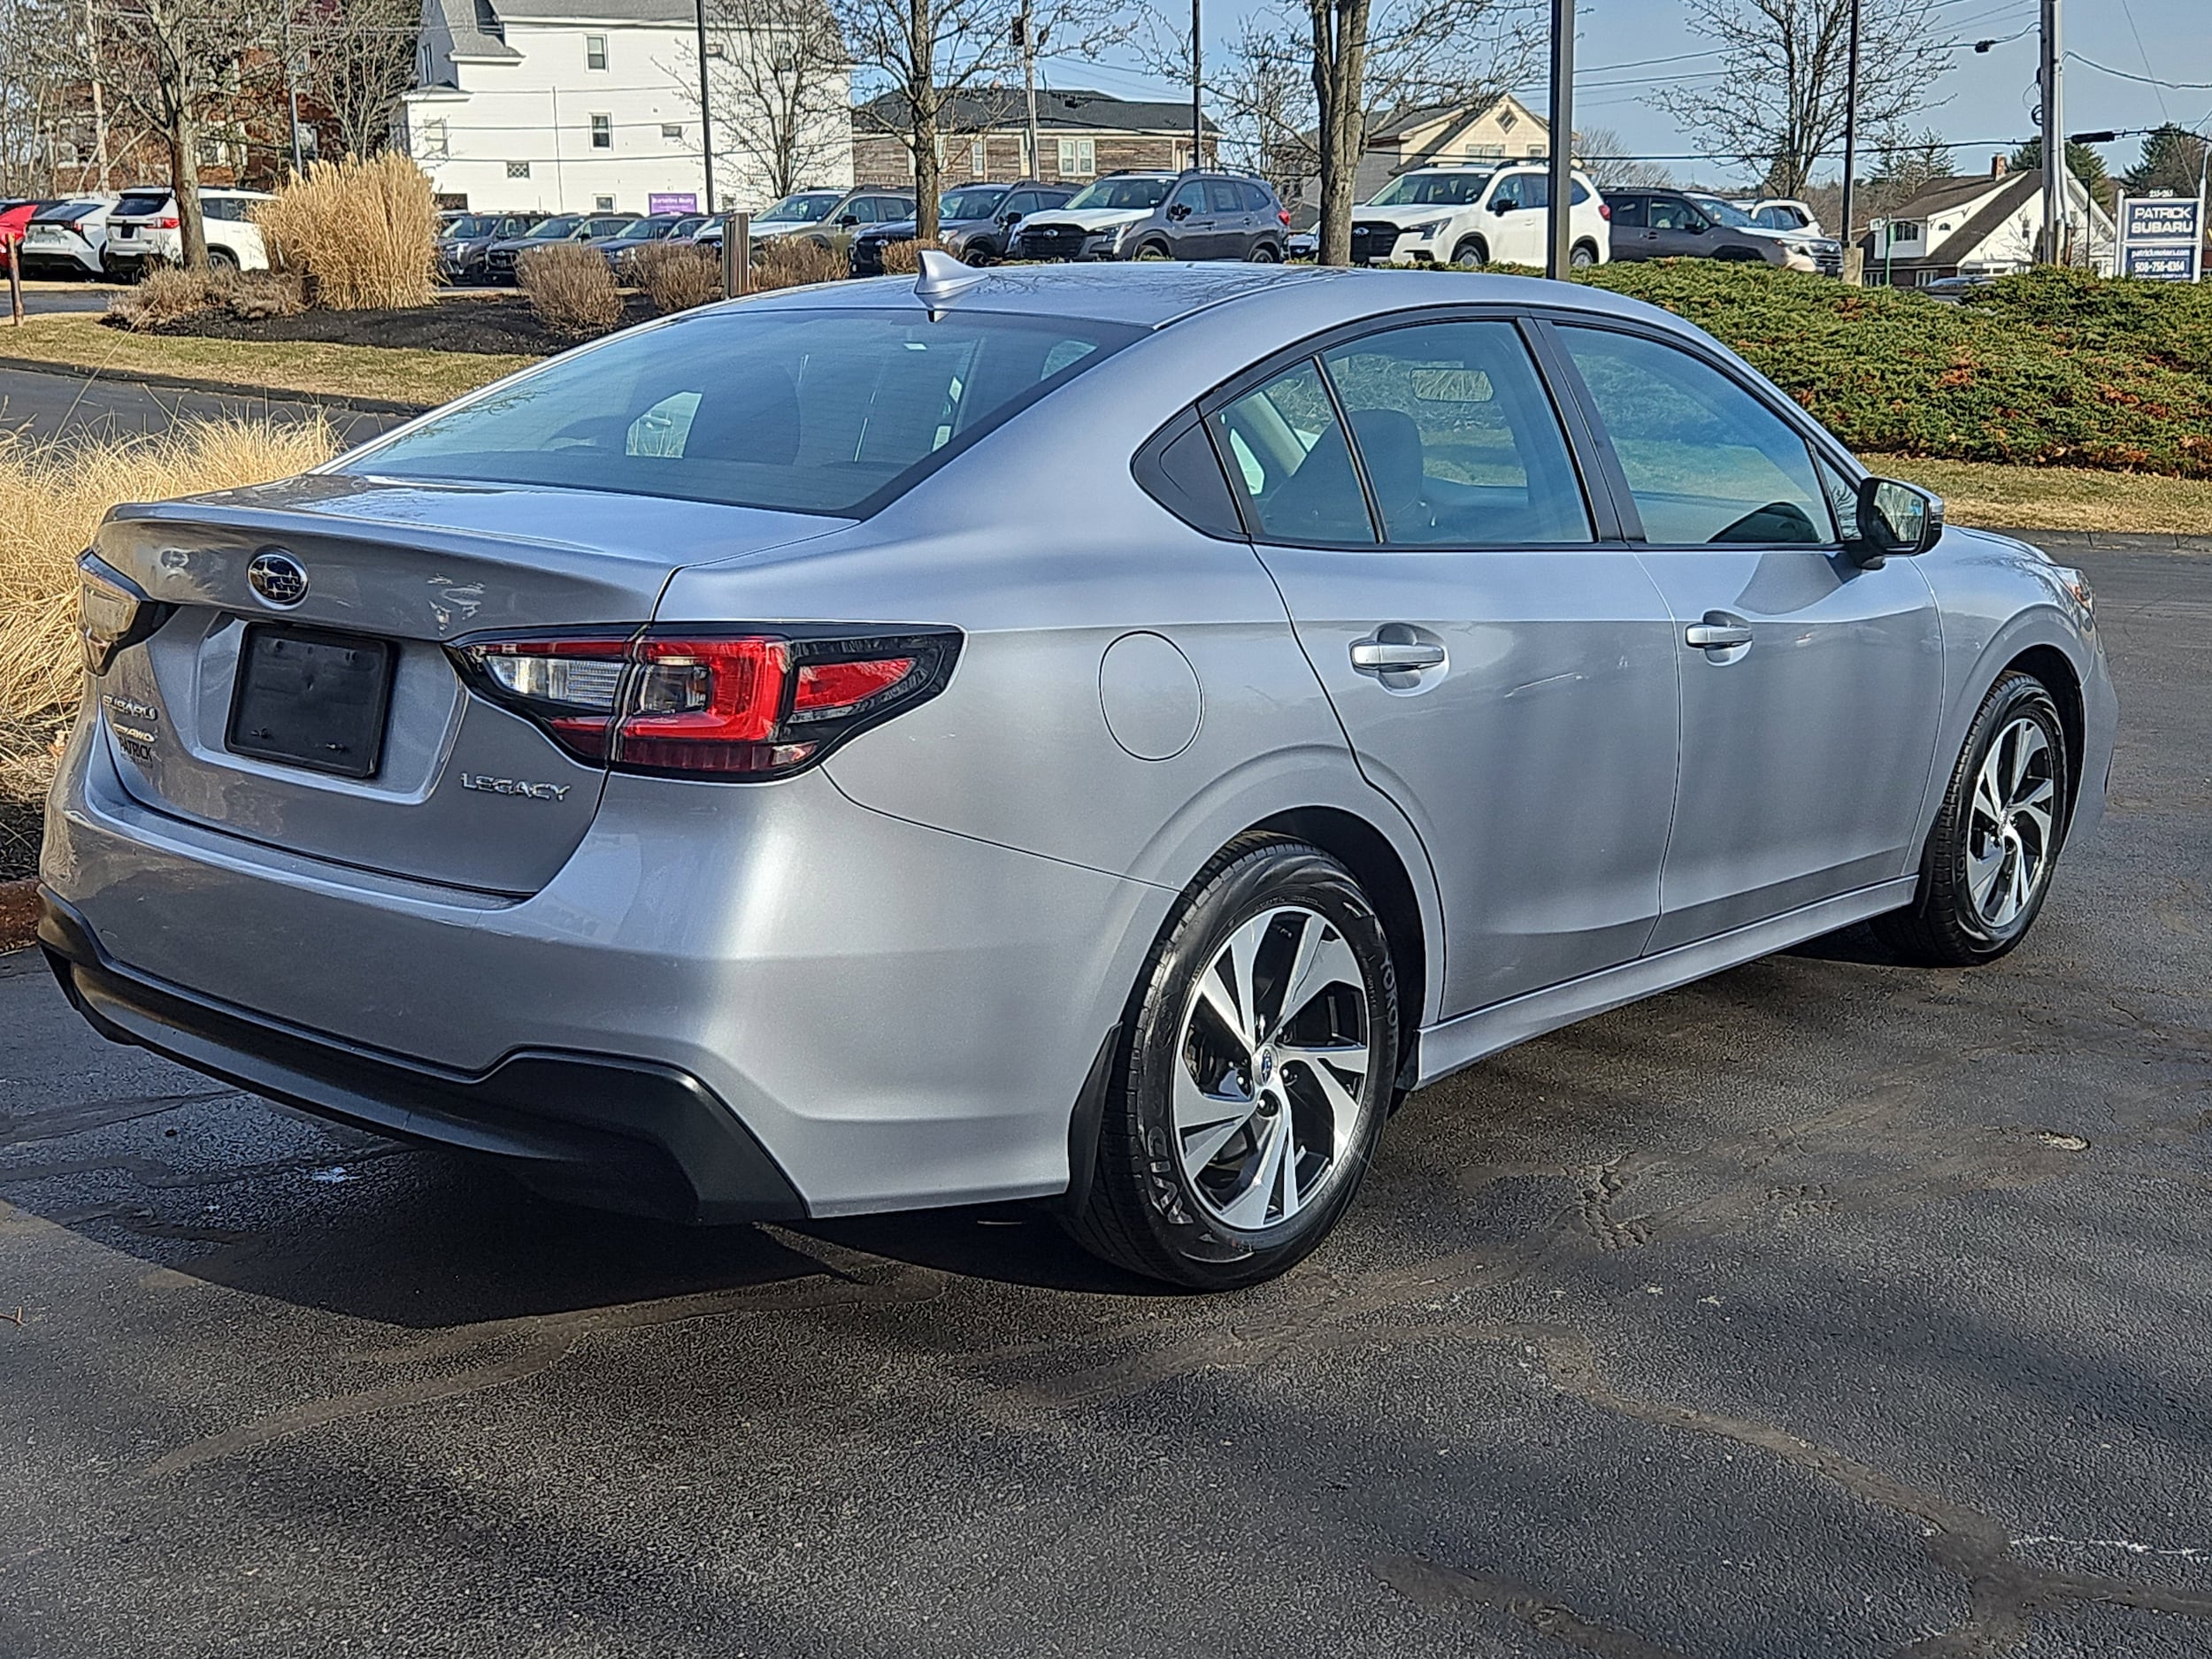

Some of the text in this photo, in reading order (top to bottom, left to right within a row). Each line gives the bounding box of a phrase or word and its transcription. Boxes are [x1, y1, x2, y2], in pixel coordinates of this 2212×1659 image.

[2134, 207, 2193, 219] PATRICK
[2131, 220, 2193, 234] SUBARU
[119, 737, 153, 762] PATRICK
[460, 772, 572, 802] LEGACY
